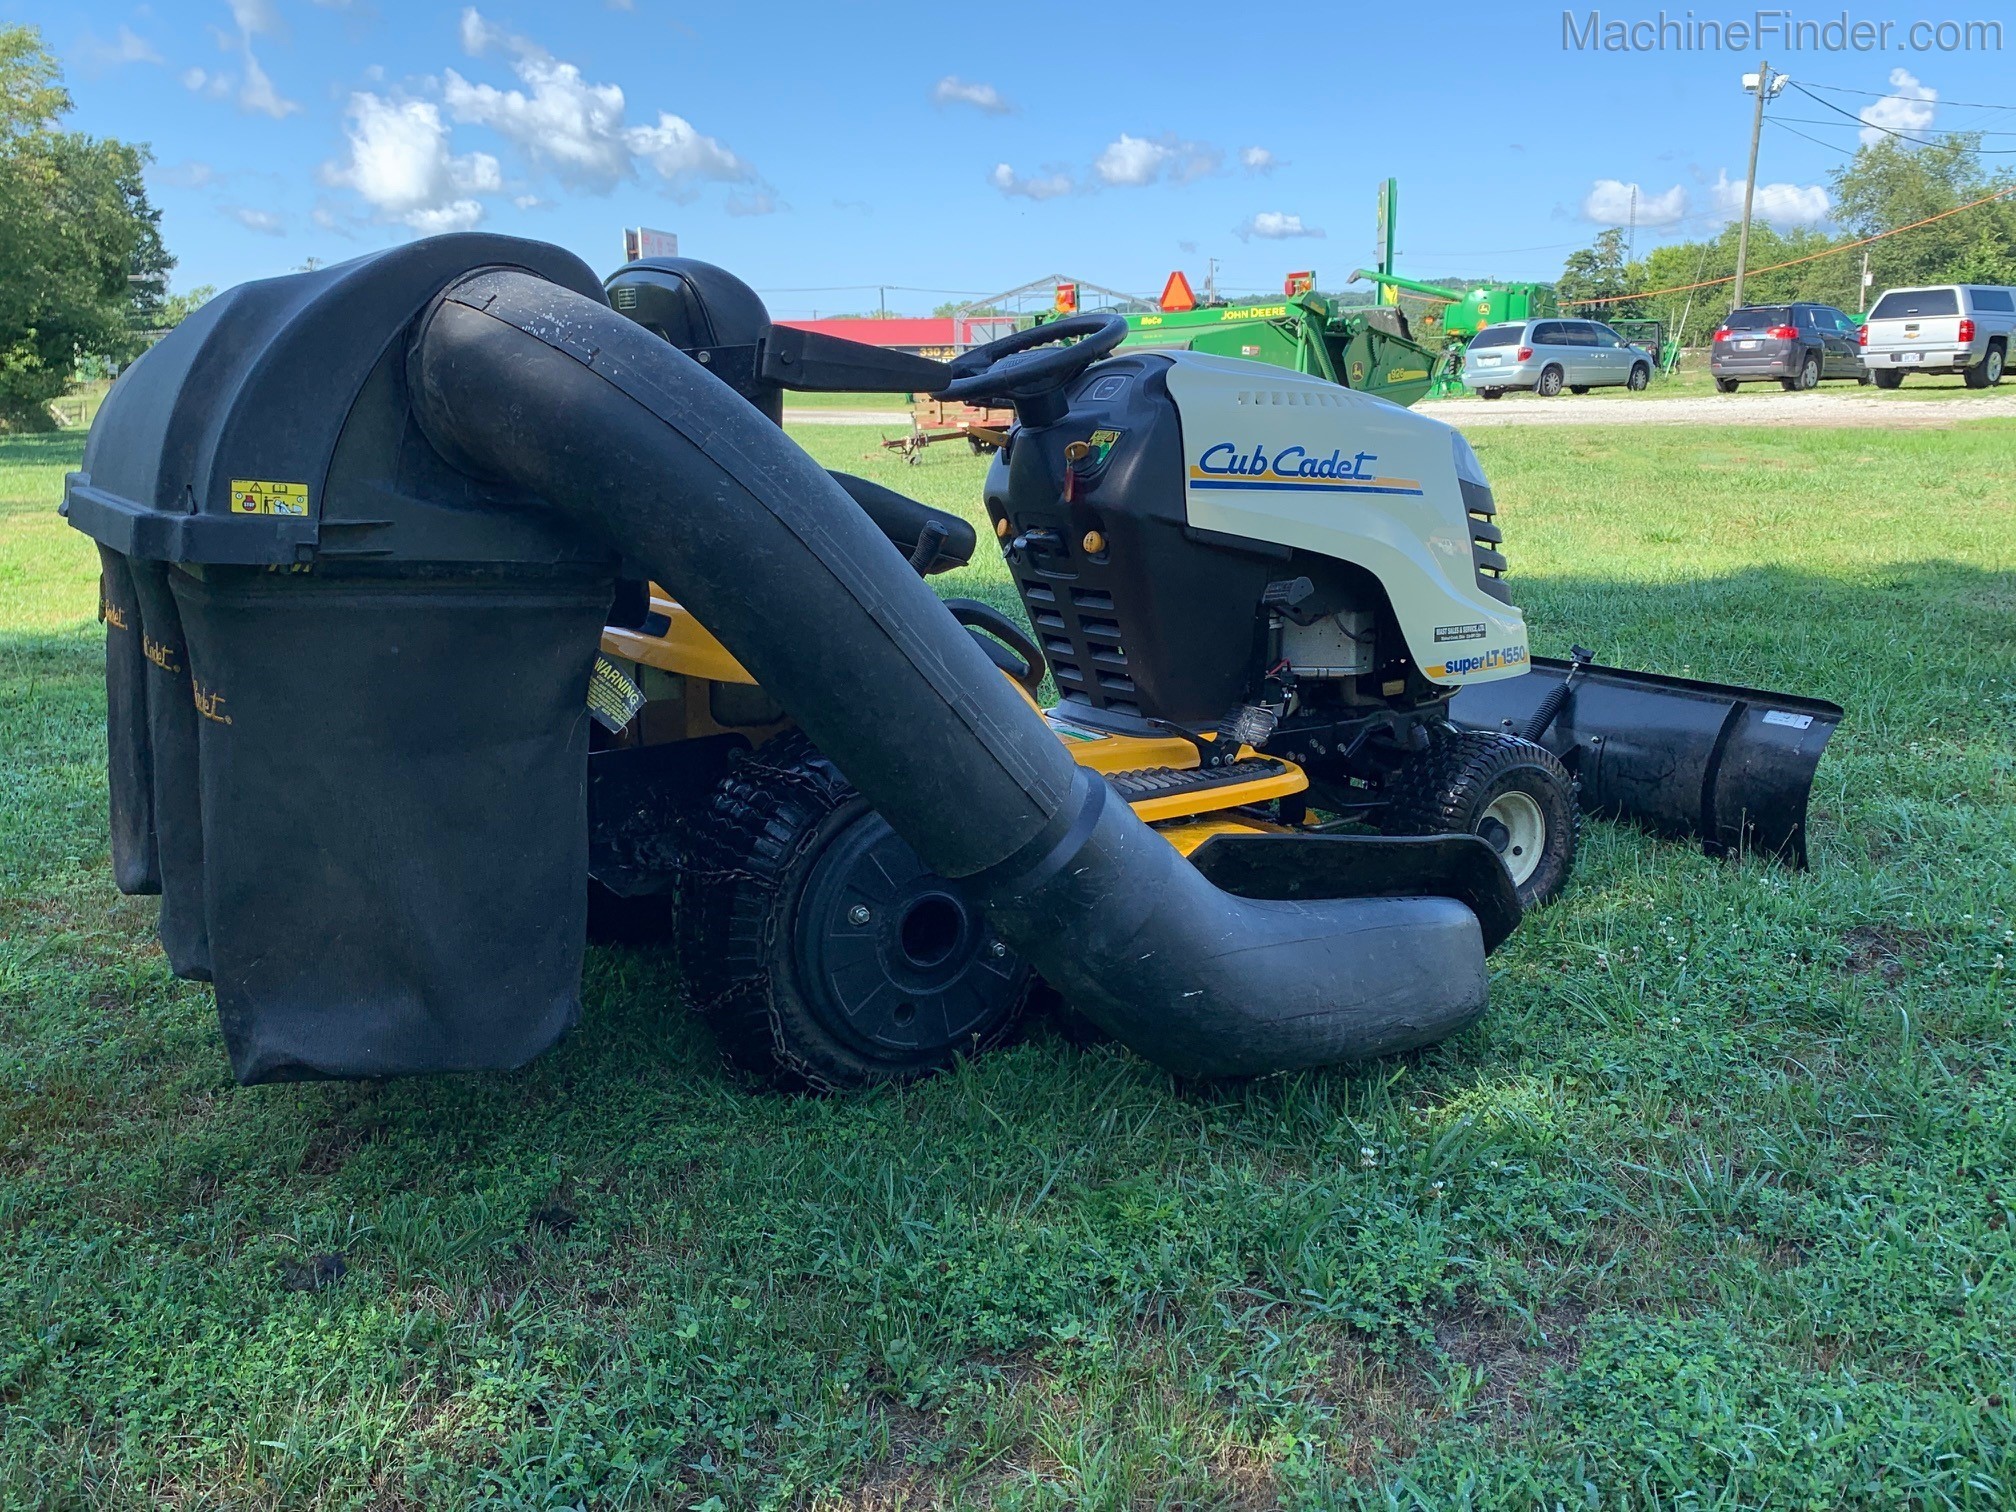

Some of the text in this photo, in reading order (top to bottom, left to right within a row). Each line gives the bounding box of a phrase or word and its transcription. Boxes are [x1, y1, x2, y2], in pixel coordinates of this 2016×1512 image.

[1220, 306, 1287, 321] JOHN DEERE
[919, 347, 941, 357] 330
[1199, 442, 1378, 480] Cub Cadet
[1445, 645, 1525, 675] super LT 1550
[594, 656, 639, 705] WARNING
